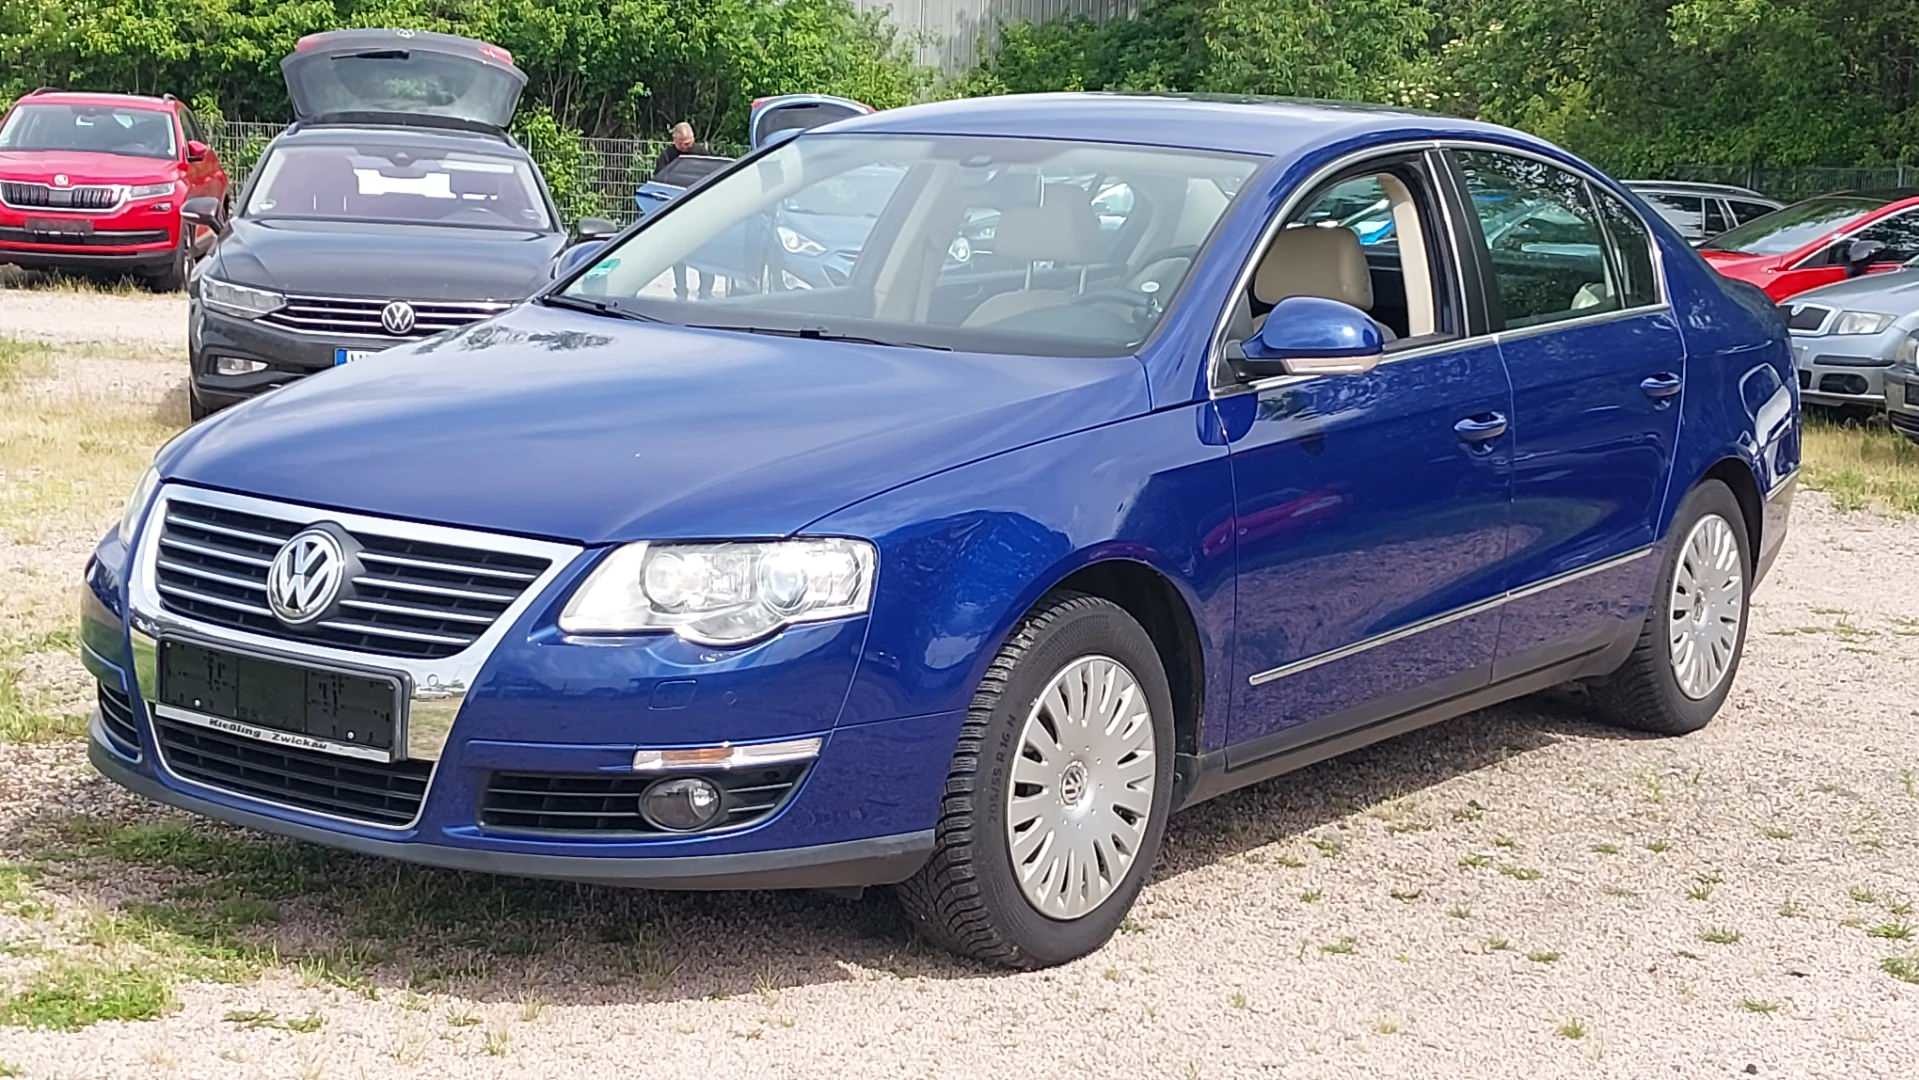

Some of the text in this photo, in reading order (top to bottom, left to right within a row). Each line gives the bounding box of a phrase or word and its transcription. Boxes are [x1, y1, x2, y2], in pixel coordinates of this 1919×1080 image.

[383, 302, 414, 333] VW
[270, 533, 339, 618] VW
[271, 733, 328, 750] Zwickau
